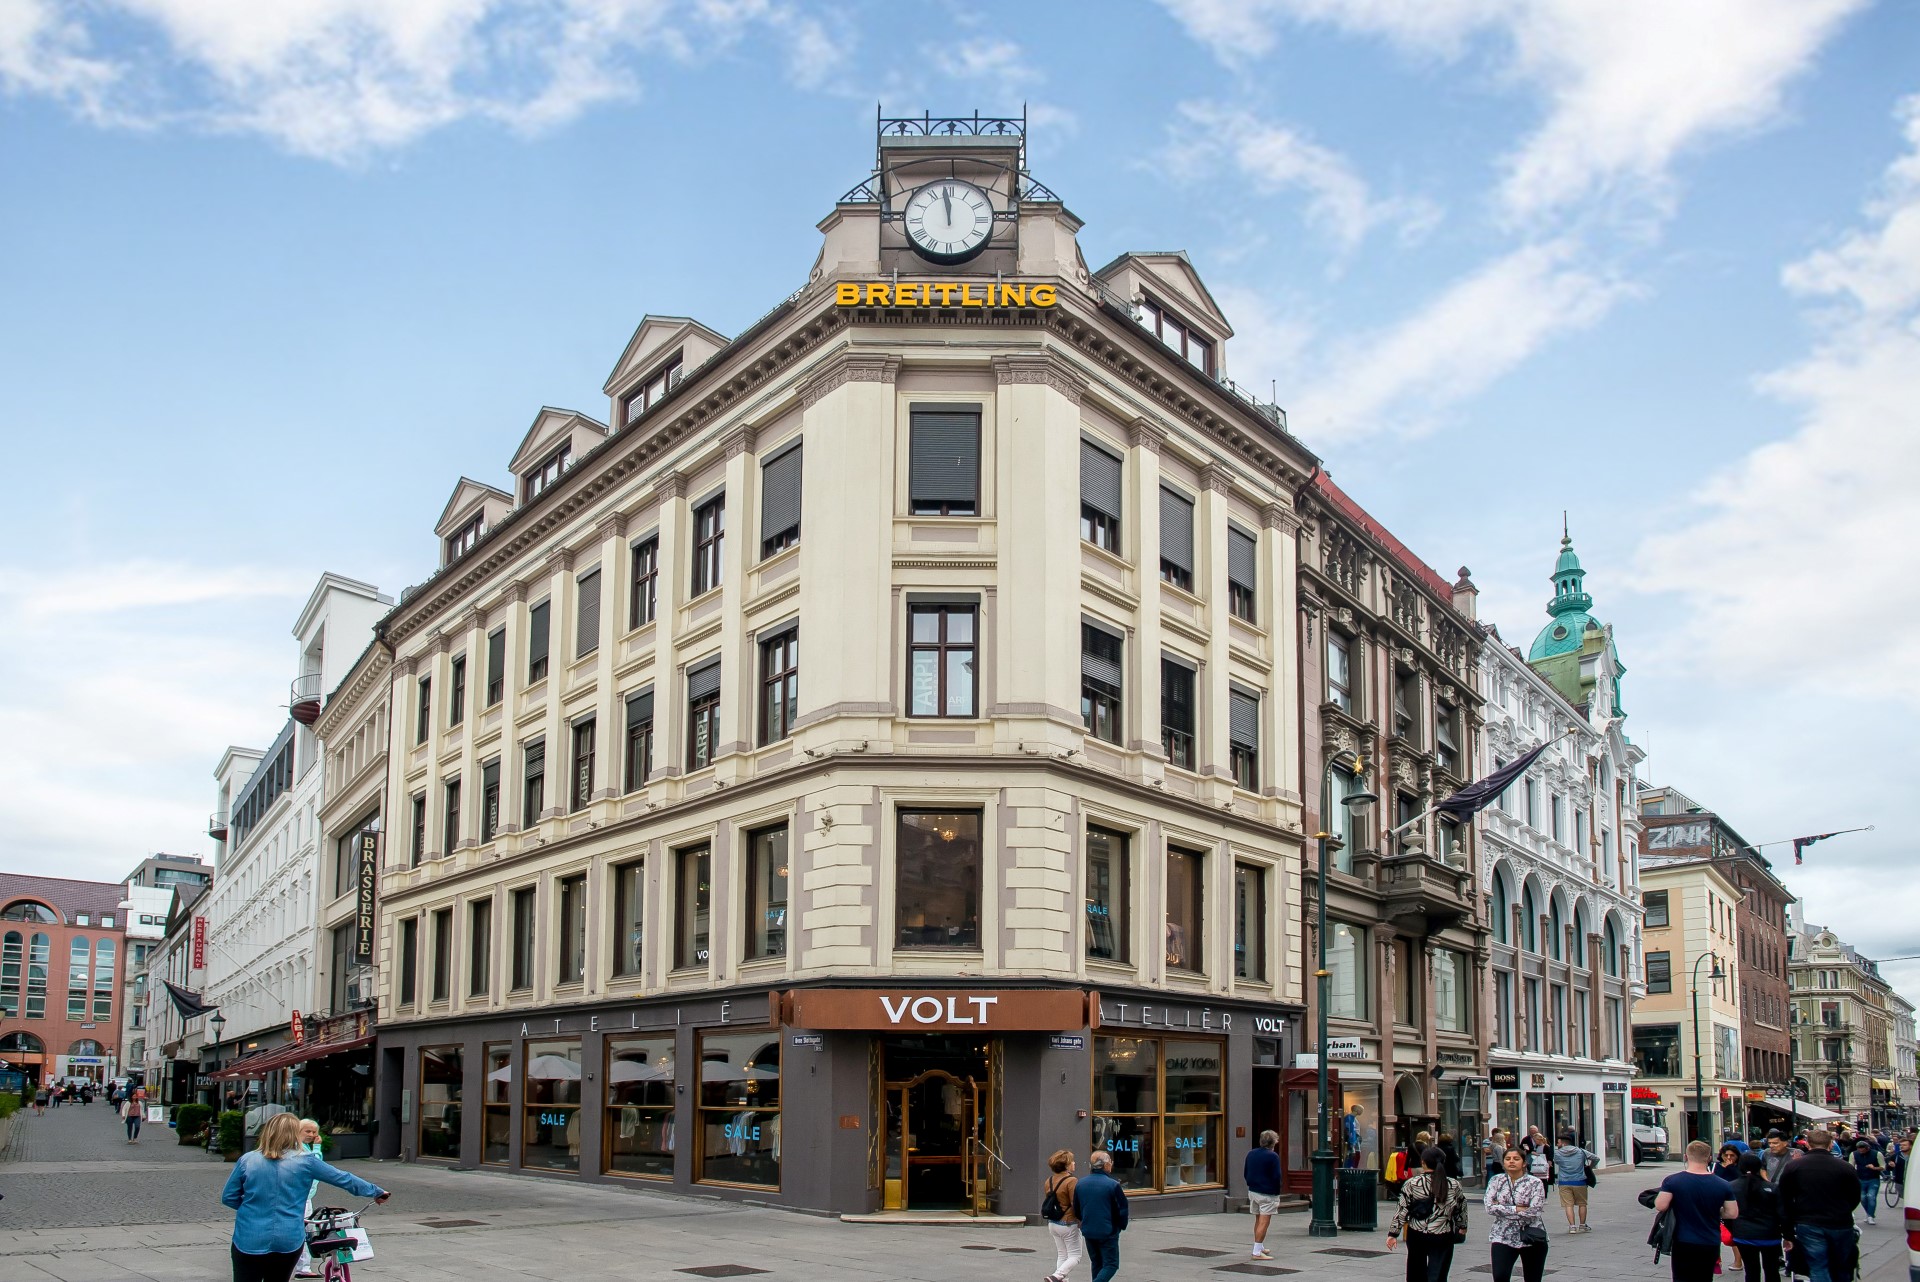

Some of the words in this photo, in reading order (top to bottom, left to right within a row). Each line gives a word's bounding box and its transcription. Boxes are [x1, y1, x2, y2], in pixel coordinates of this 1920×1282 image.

[836, 283, 1057, 307] BREITLING
[359, 837, 374, 955] BRASSERIE
[1087, 904, 1108, 915] SALE
[697, 951, 708, 960] VO
[879, 996, 998, 1025] VOLT
[1255, 1017, 1285, 1033] VOLT
[1327, 1041, 1357, 1050] rban.
[541, 1113, 565, 1126] SALE
[724, 1123, 760, 1141] SALE
[1107, 1139, 1139, 1152] SALE
[1175, 1136, 1204, 1149] SALE
